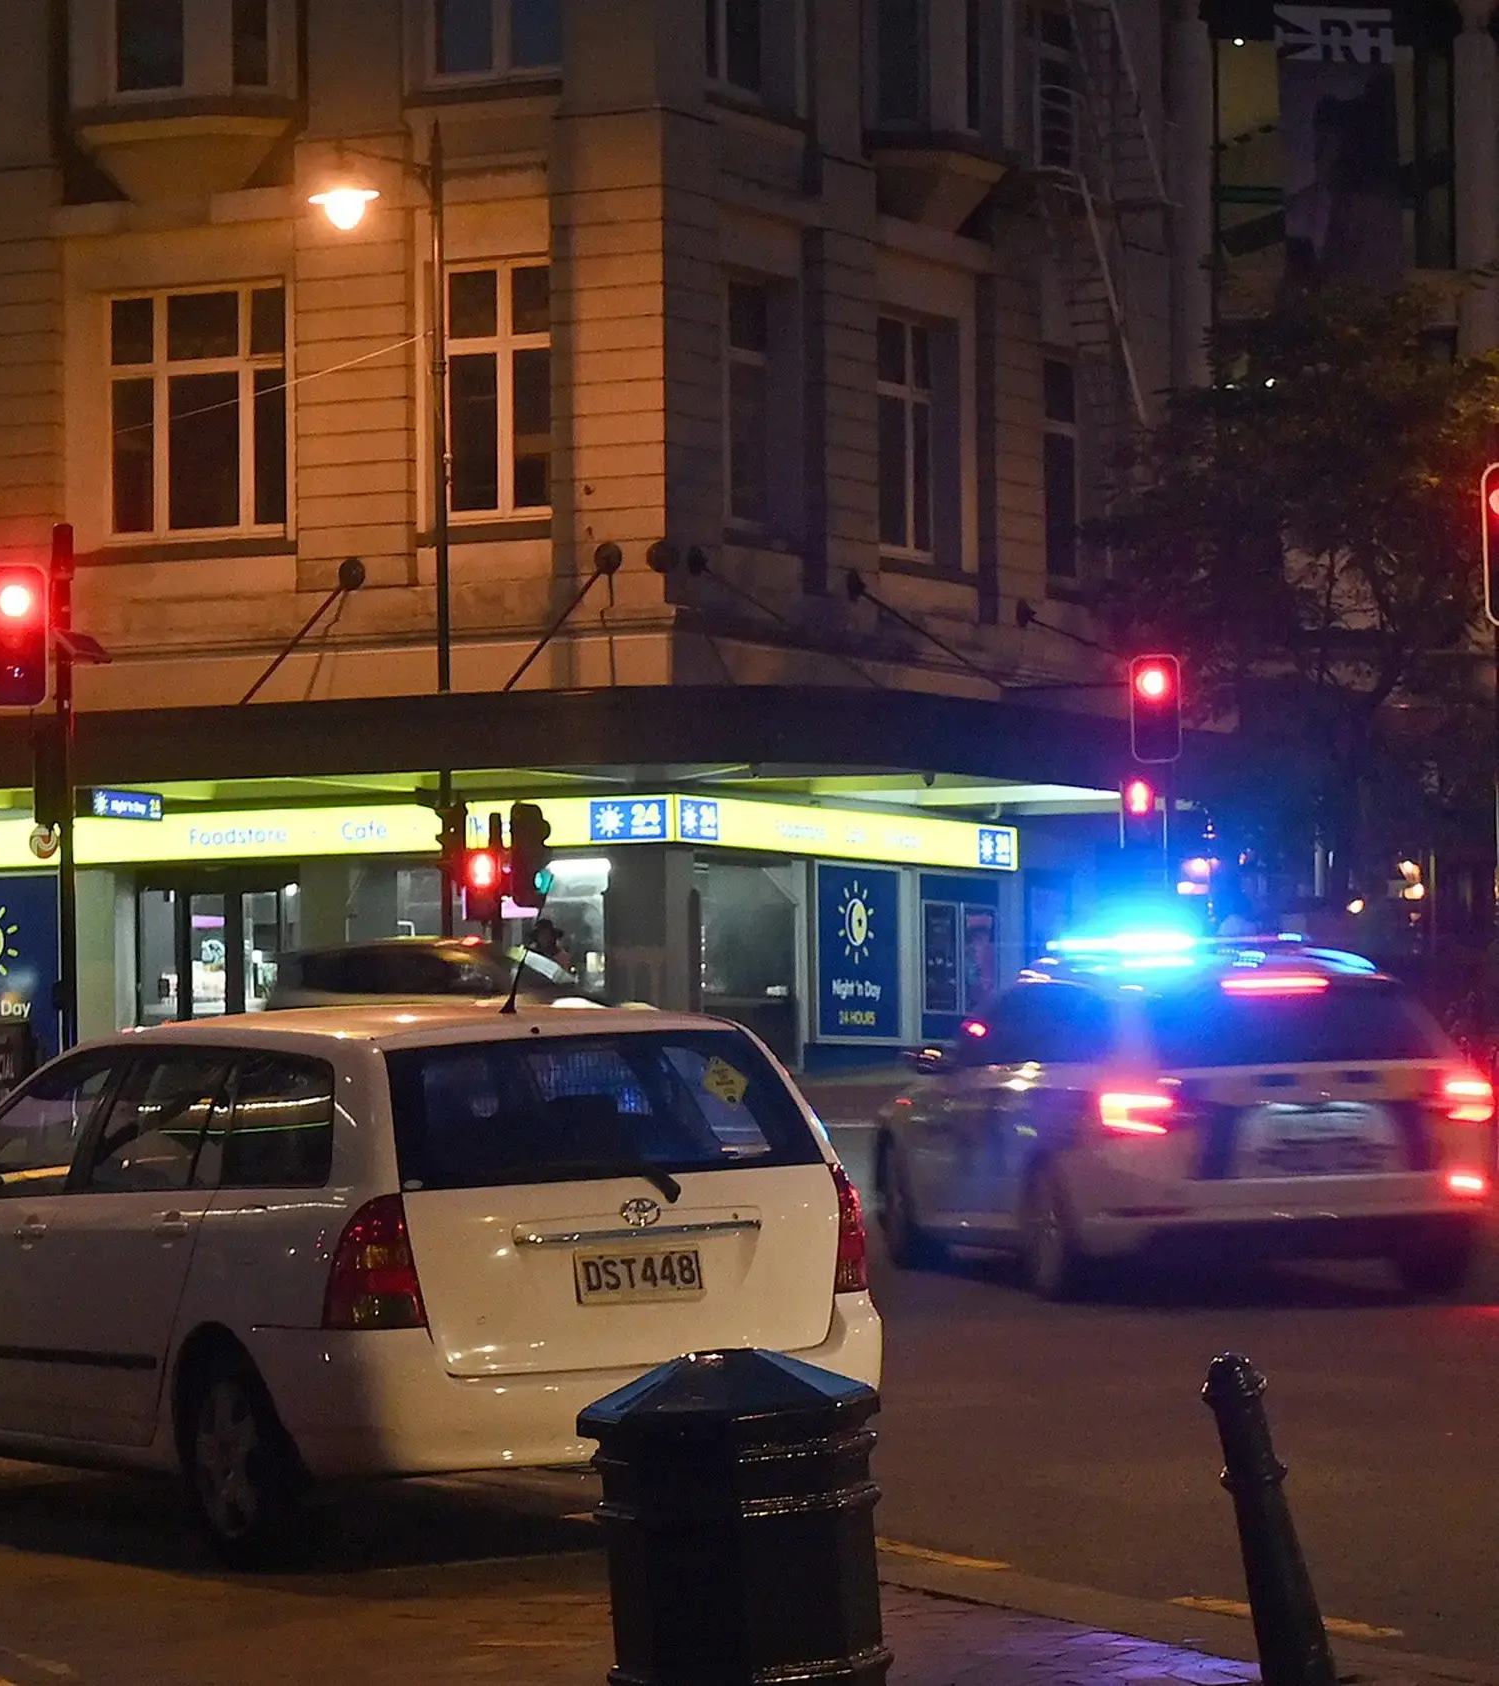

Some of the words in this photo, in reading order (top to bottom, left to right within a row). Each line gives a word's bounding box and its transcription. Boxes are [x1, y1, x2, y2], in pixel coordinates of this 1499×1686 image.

[630, 803, 661, 826] 24
[189, 827, 288, 846] Foodstore
[341, 822, 388, 840] Cafe
[864, 980, 881, 1002] Day
[1, 1001, 31, 1018] Day
[582, 1255, 696, 1291] DST448
